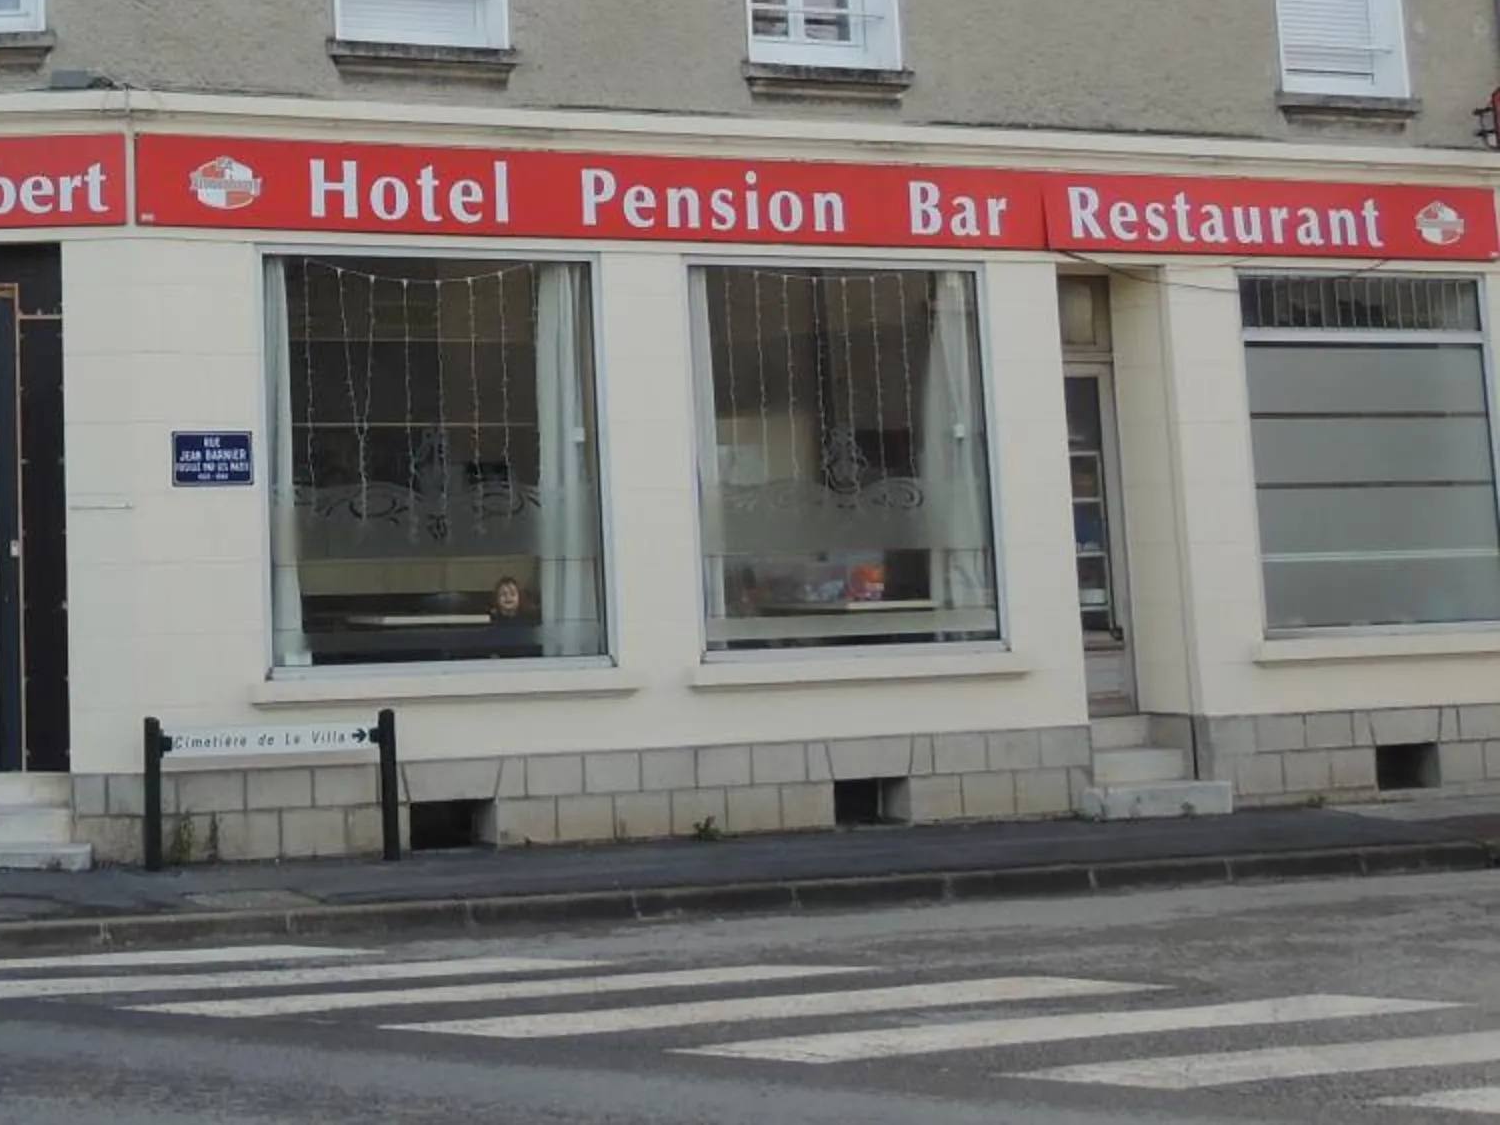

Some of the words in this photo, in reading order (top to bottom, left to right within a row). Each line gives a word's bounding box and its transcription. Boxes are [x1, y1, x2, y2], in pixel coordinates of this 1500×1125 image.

[308, 158, 510, 224] Hotel
[580, 170, 847, 233] Pension
[907, 180, 1008, 237] Bar
[1067, 185, 1385, 249] Restaurant
[180, 450, 202, 461] JEAN
[257, 733, 275, 748] de
